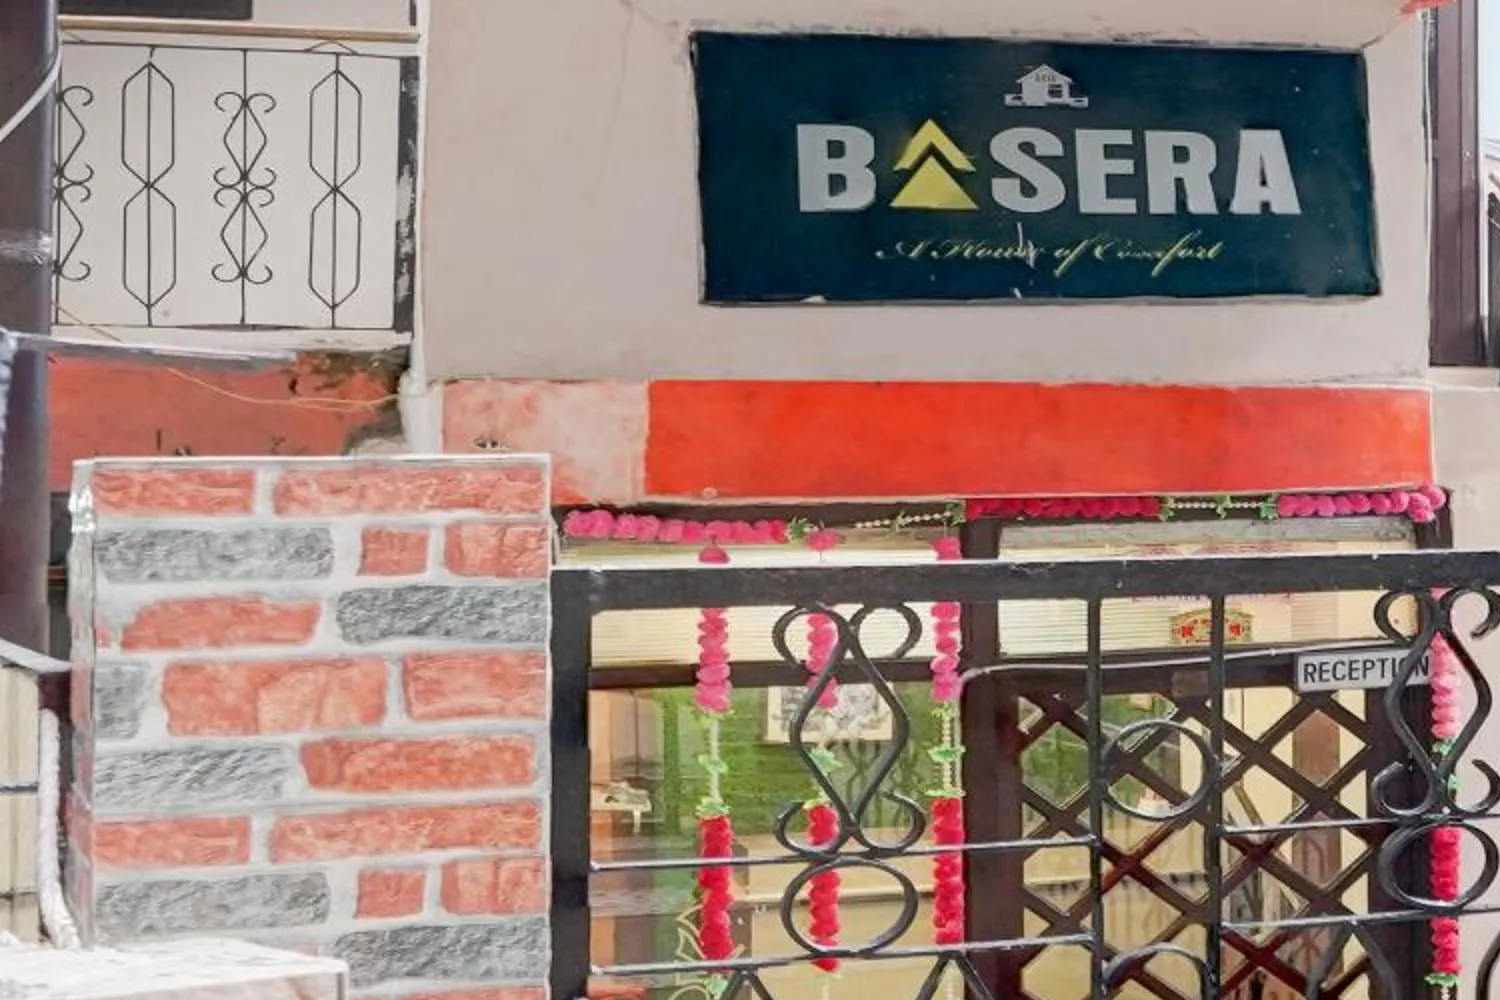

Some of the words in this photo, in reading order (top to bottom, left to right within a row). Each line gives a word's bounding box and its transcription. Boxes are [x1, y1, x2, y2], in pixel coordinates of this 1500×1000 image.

[796, 119, 1302, 215] BASERA
[1053, 231, 1100, 278] of
[1303, 655, 1429, 683] RECEPTIN
